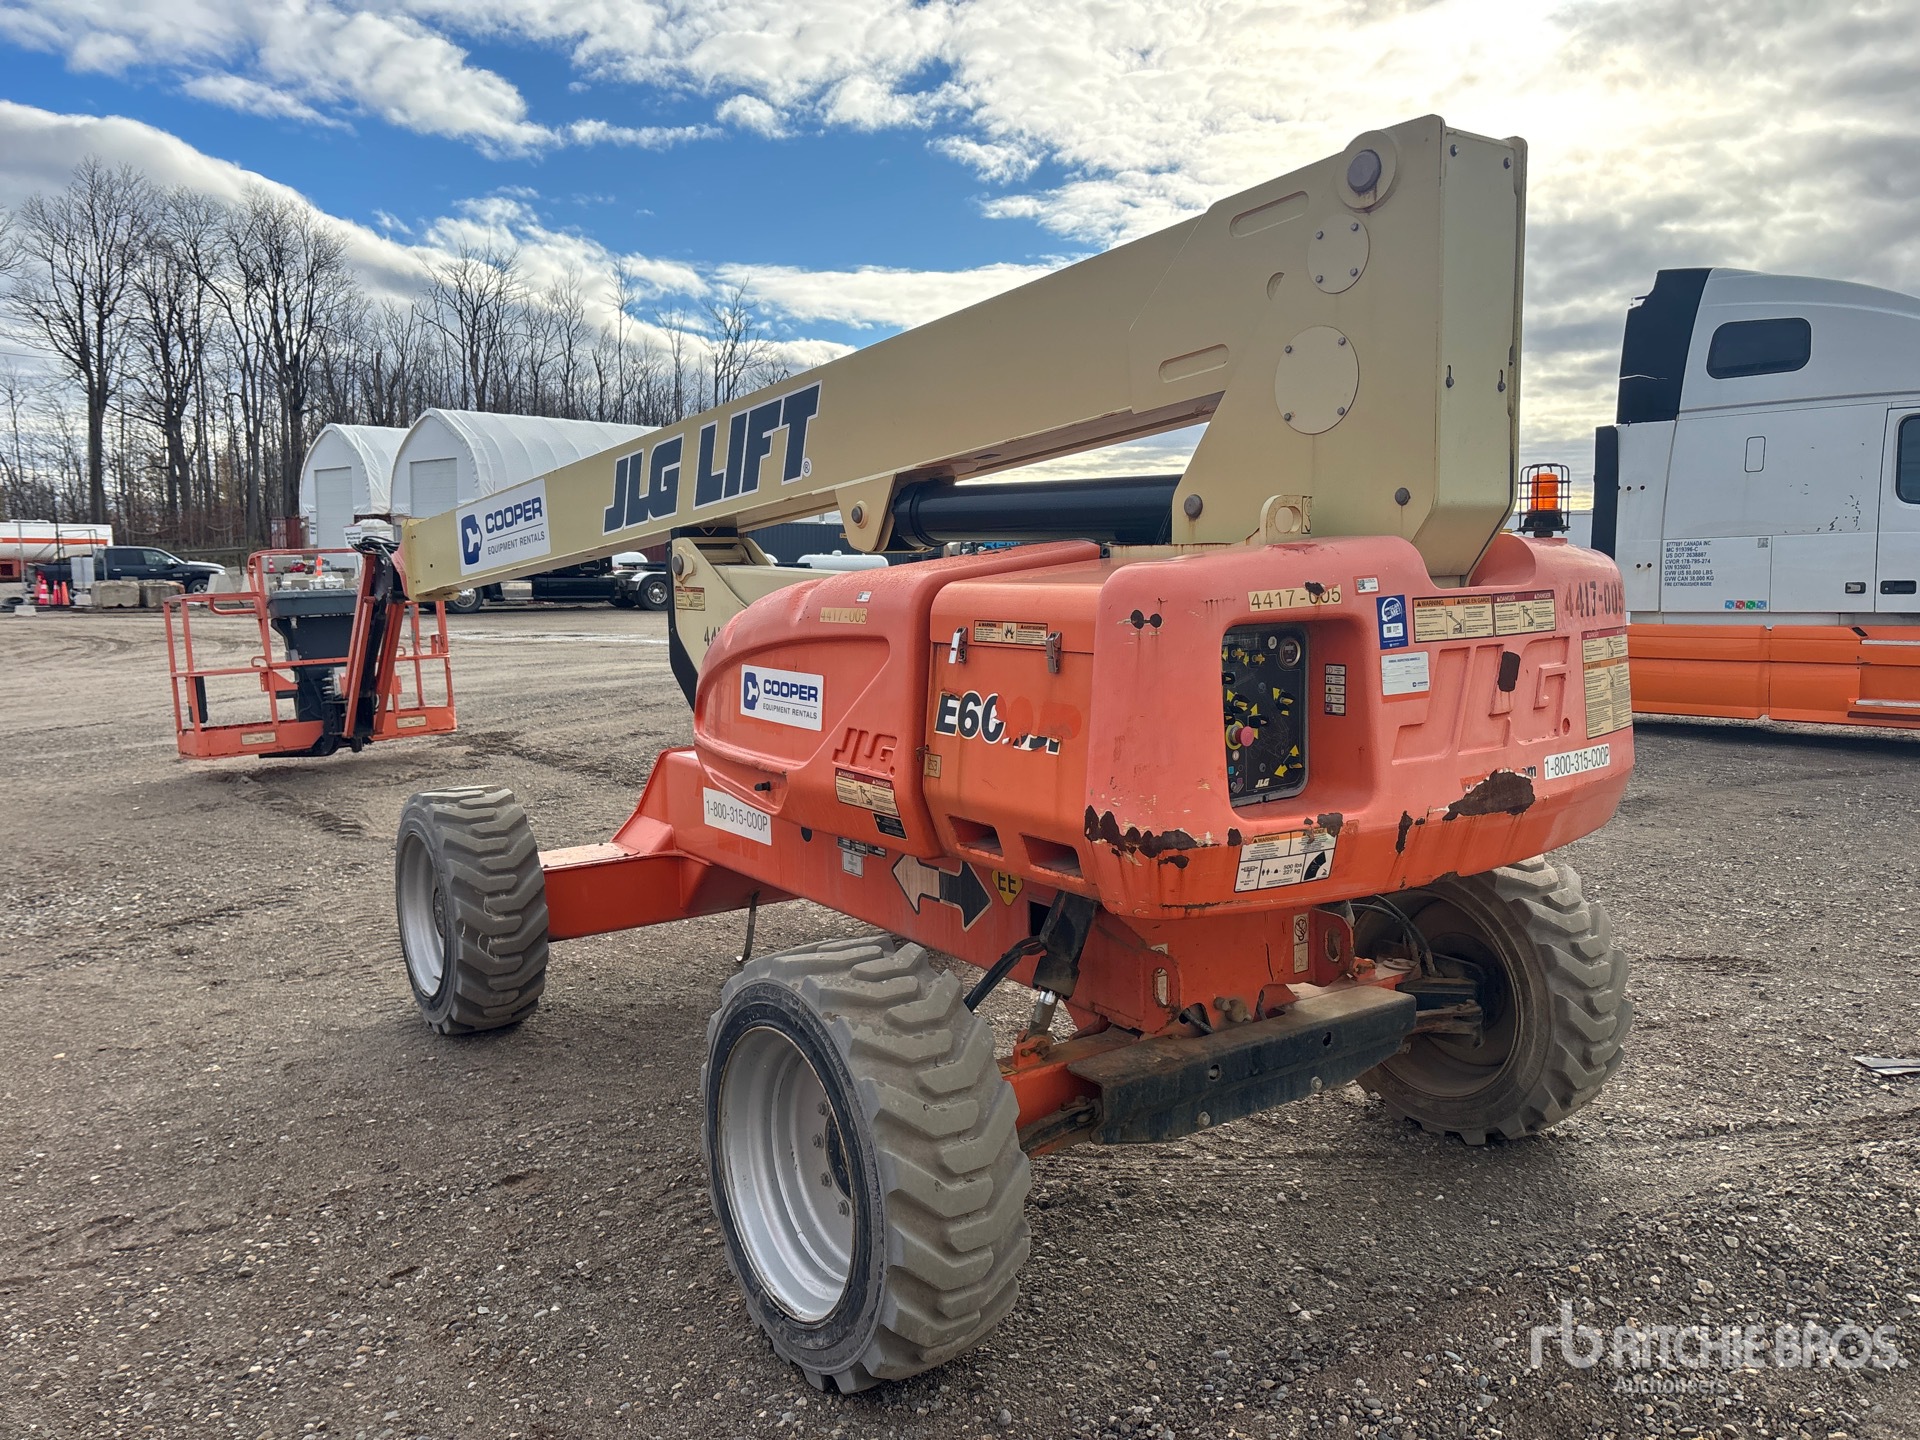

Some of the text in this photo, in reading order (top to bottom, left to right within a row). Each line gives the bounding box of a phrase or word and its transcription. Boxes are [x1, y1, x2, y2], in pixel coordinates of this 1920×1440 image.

[603, 380, 822, 536] JLG LIFT
[485, 497, 542, 534] COOPER
[487, 531, 545, 555] EQUIPMENT RENTALS
[763, 679, 818, 702] COOPER
[763, 703, 818, 720] EQUIPMENT RENTALS
[832, 727, 897, 776] JLG
[1545, 746, 1609, 778] 1-800-315-COOP
[1255, 778, 1270, 788] JLG
[706, 800, 768, 832] 1-800-315-COOP
